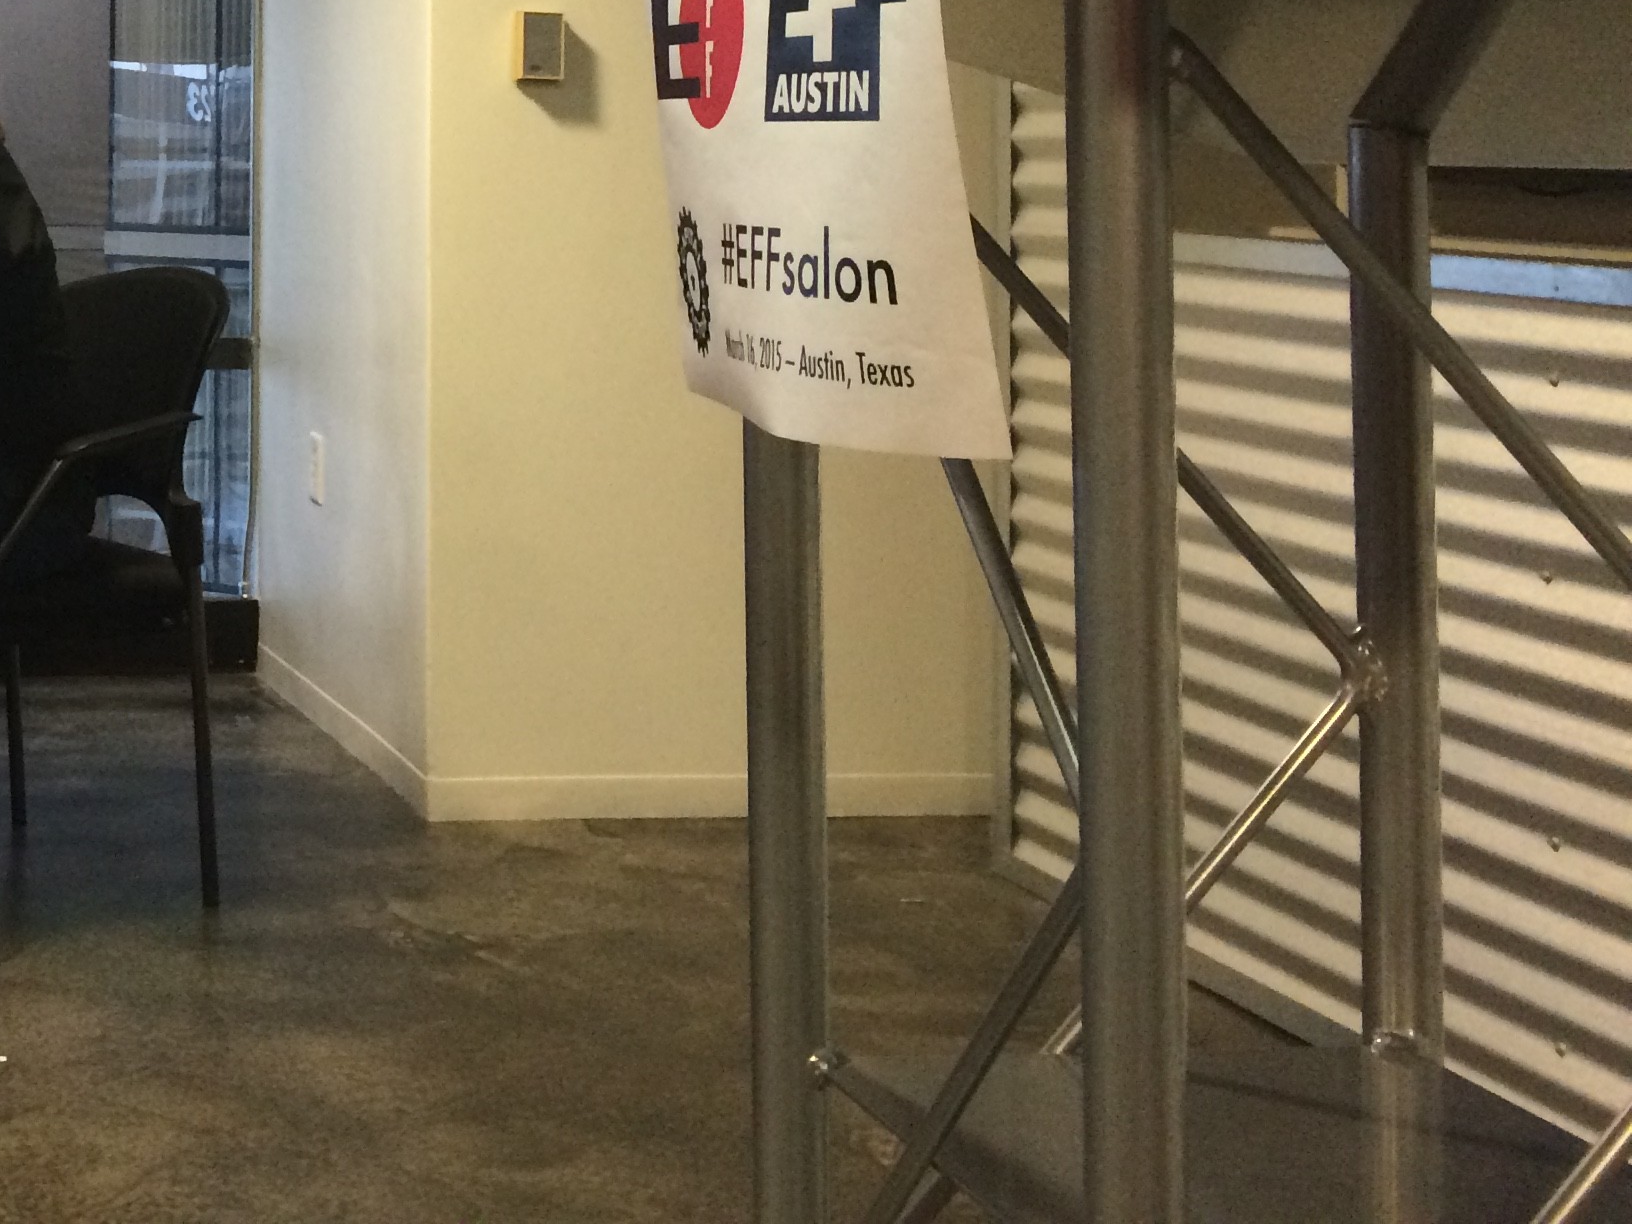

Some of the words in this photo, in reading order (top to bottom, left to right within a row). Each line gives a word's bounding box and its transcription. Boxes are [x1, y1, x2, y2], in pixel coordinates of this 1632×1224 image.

[772, 71, 869, 113] AUSTIN
[721, 223, 898, 305] #EFFsalon
[760, 337, 782, 372] 2015
[799, 345, 851, 389] Austin,
[855, 352, 915, 388] Texas
